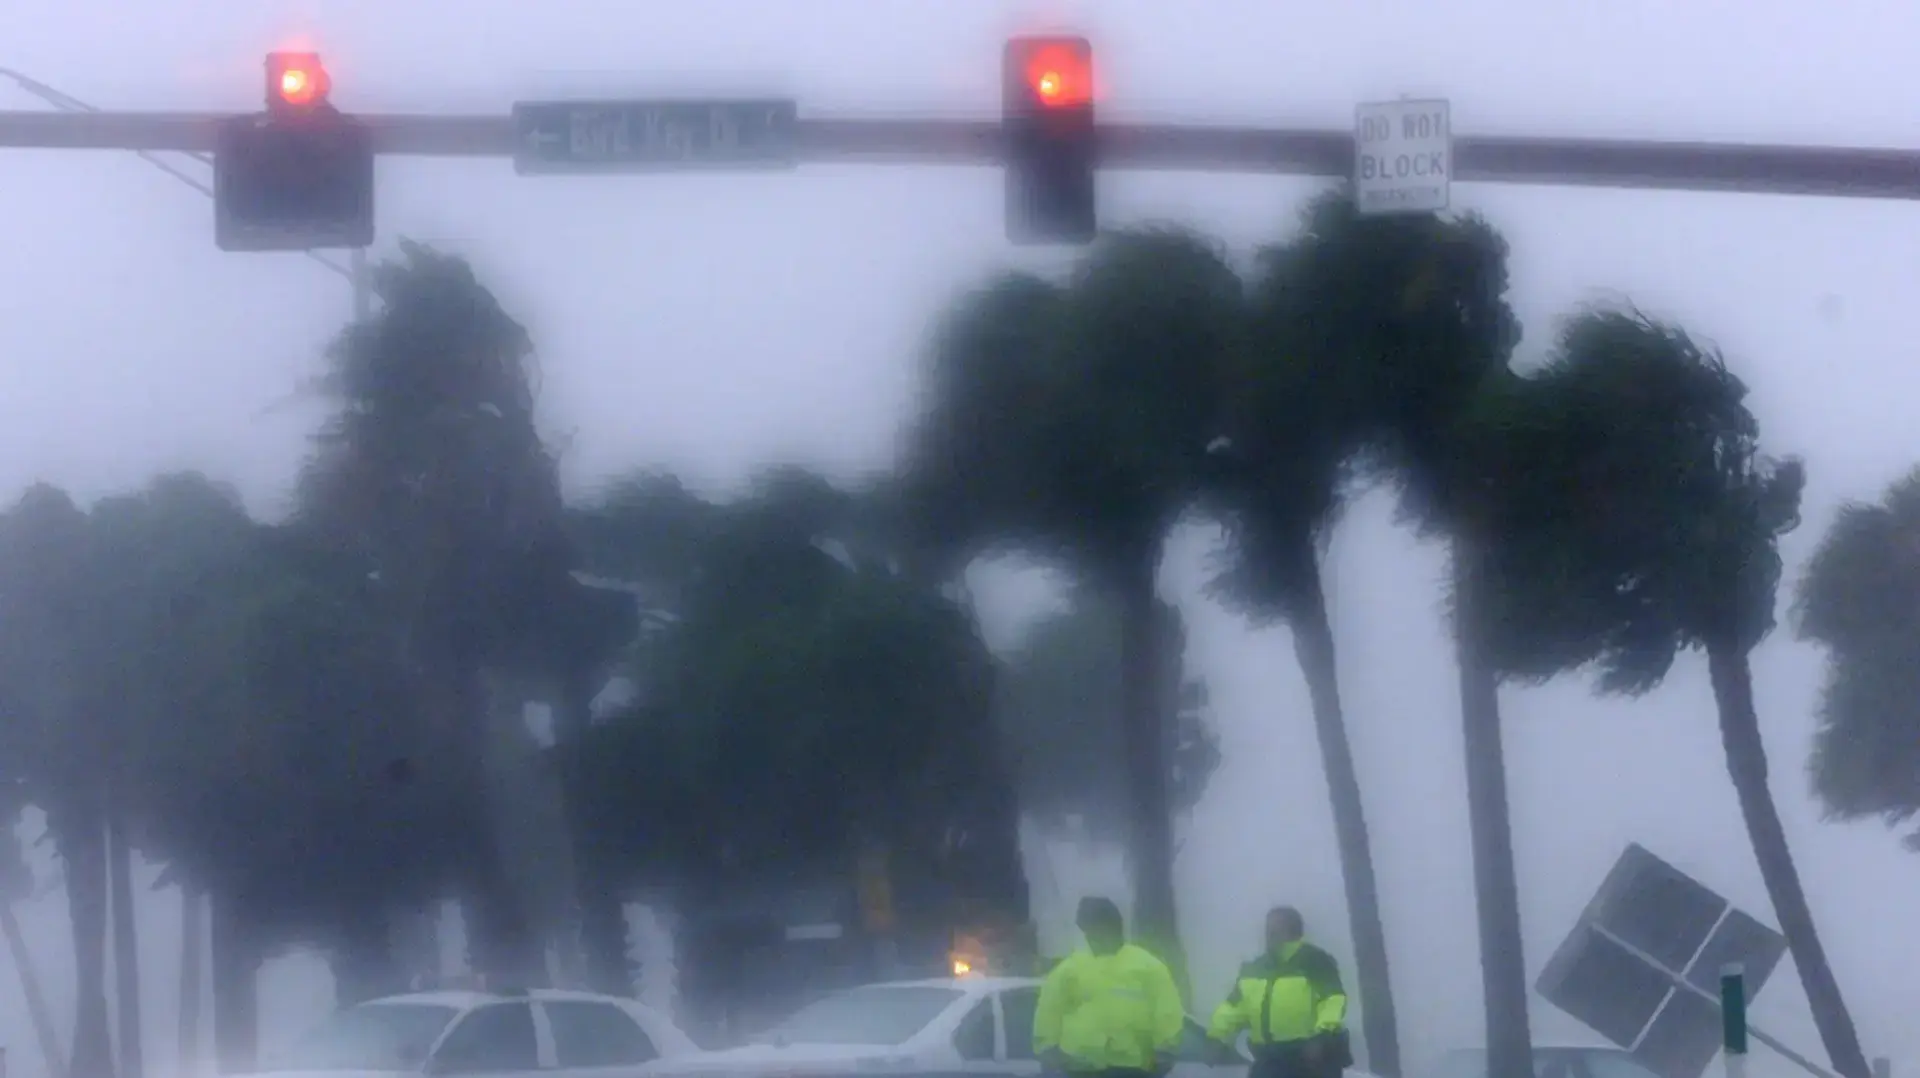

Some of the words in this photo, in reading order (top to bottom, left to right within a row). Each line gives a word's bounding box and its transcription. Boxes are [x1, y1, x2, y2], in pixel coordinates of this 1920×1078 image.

[1361, 114, 1390, 143] DO
[1401, 112, 1443, 141] NOT
[1361, 151, 1444, 181] BLOCK
